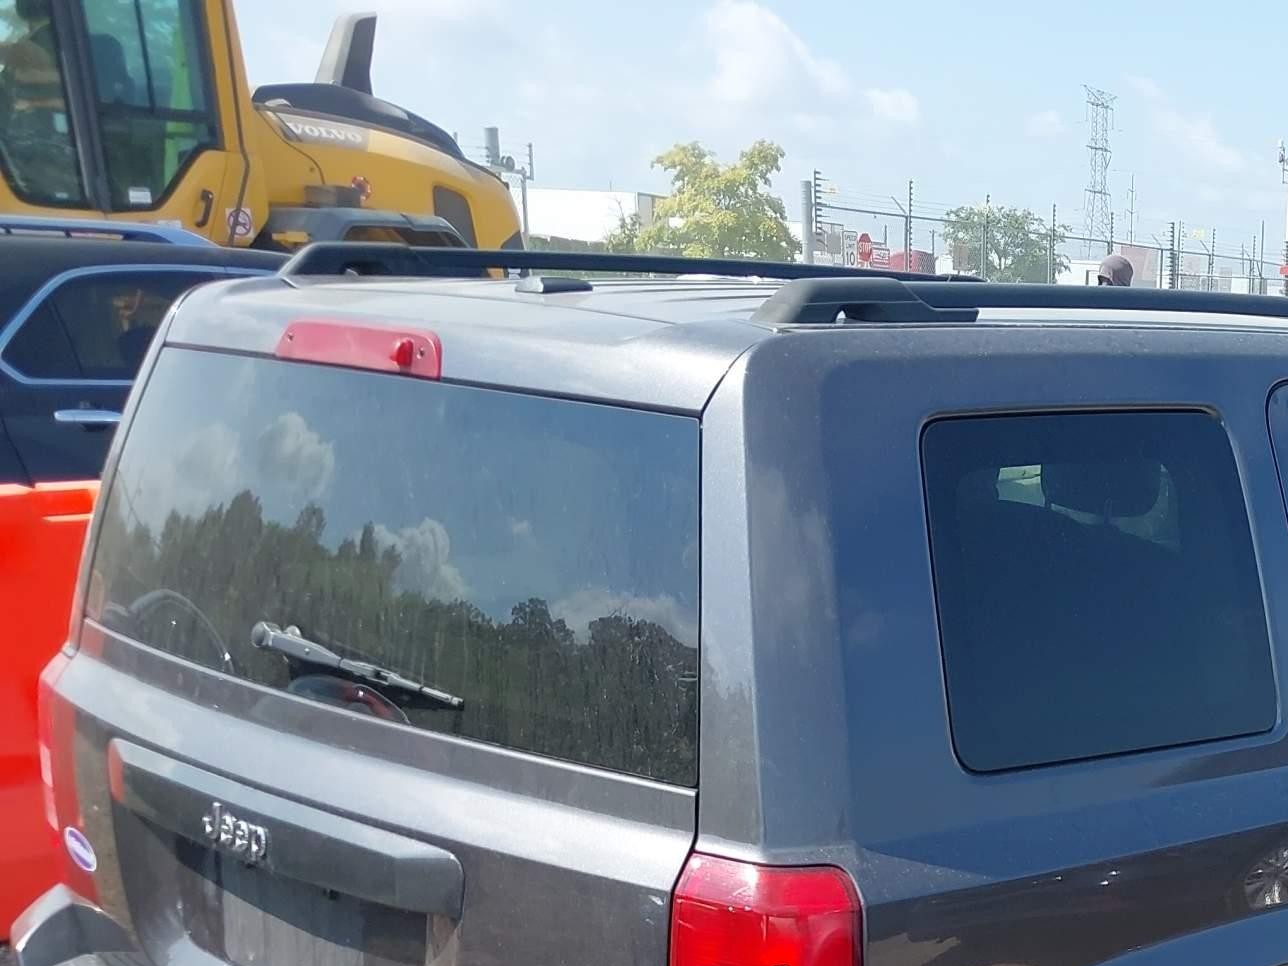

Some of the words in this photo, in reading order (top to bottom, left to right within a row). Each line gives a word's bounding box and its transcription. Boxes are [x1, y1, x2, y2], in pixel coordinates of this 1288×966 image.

[286, 121, 362, 142] VOLVO
[859, 242, 872, 253] STOP
[845, 251, 856, 266] 10
[202, 801, 266, 861] Jeep
